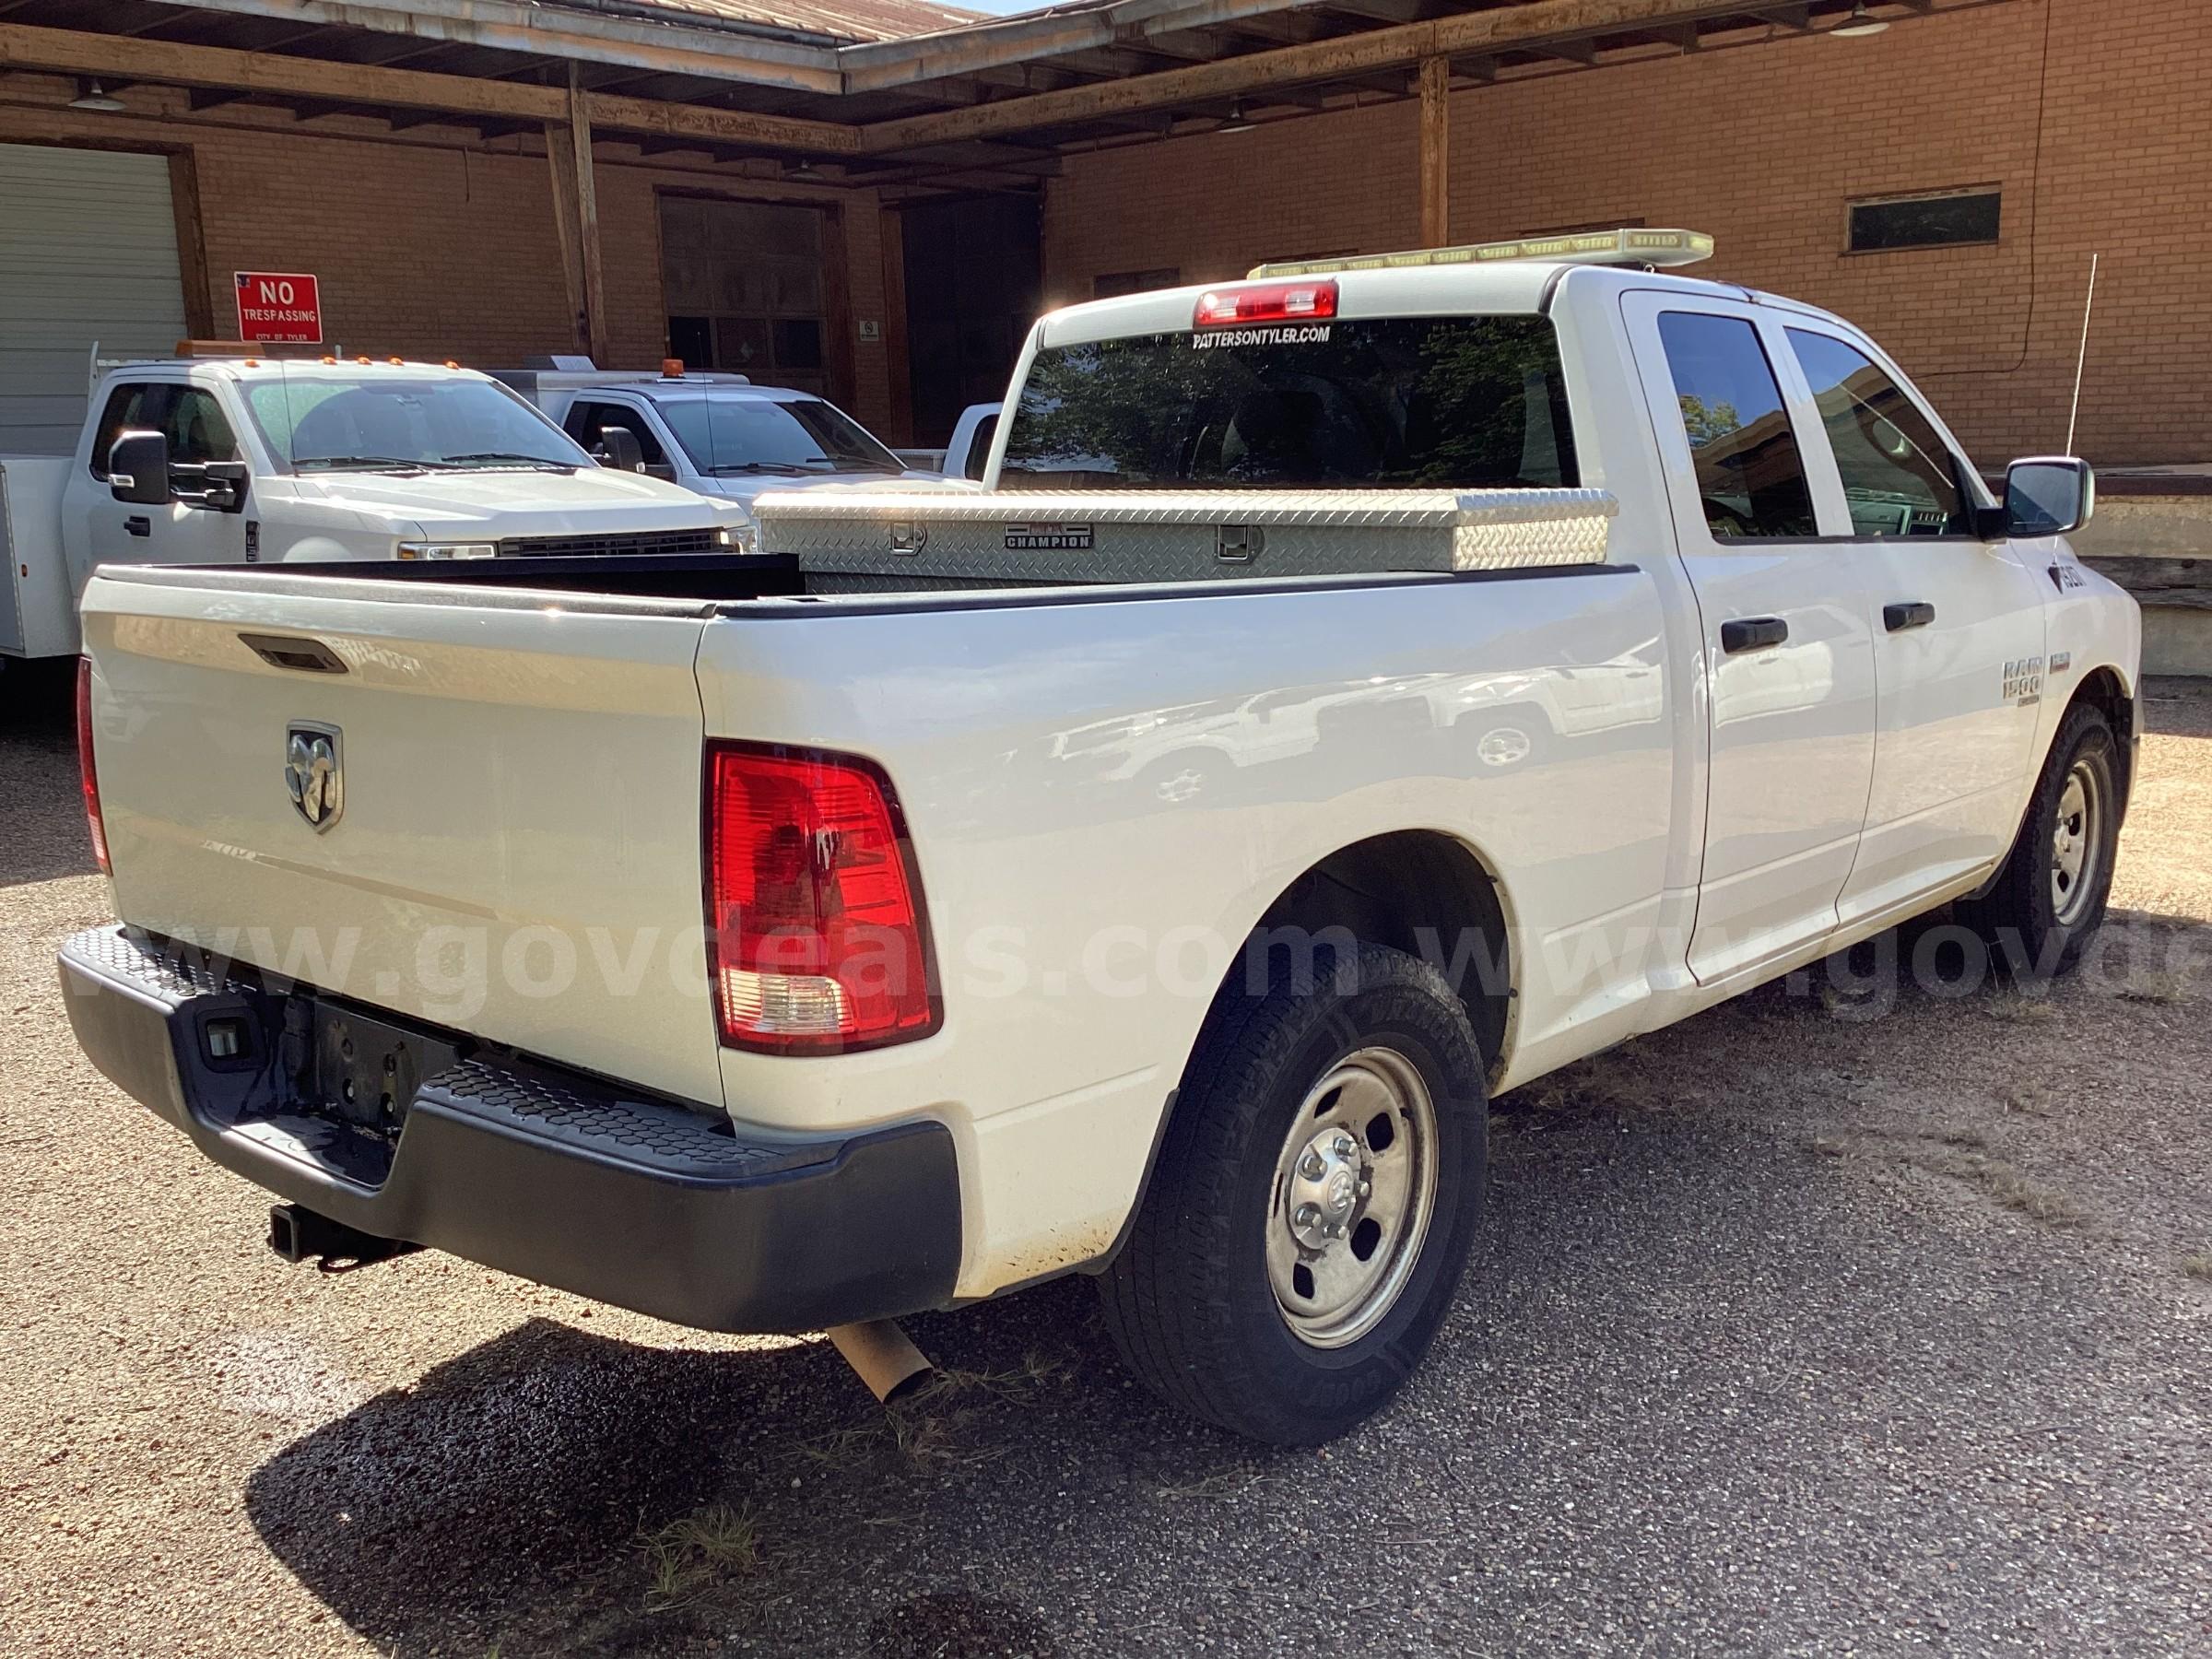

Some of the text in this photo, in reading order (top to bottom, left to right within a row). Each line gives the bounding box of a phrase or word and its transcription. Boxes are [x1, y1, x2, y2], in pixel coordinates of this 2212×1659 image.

[260, 280, 294, 305] NO
[242, 308, 316, 323] TRESPASSING
[255, 333, 309, 341] CITY OF TYLER
[1193, 325, 1331, 350] PATTERSONTYLER.COM
[1006, 536, 1088, 548] CHAMPION
[2003, 656, 2043, 680] RAM
[2002, 676, 2041, 700] 1500
